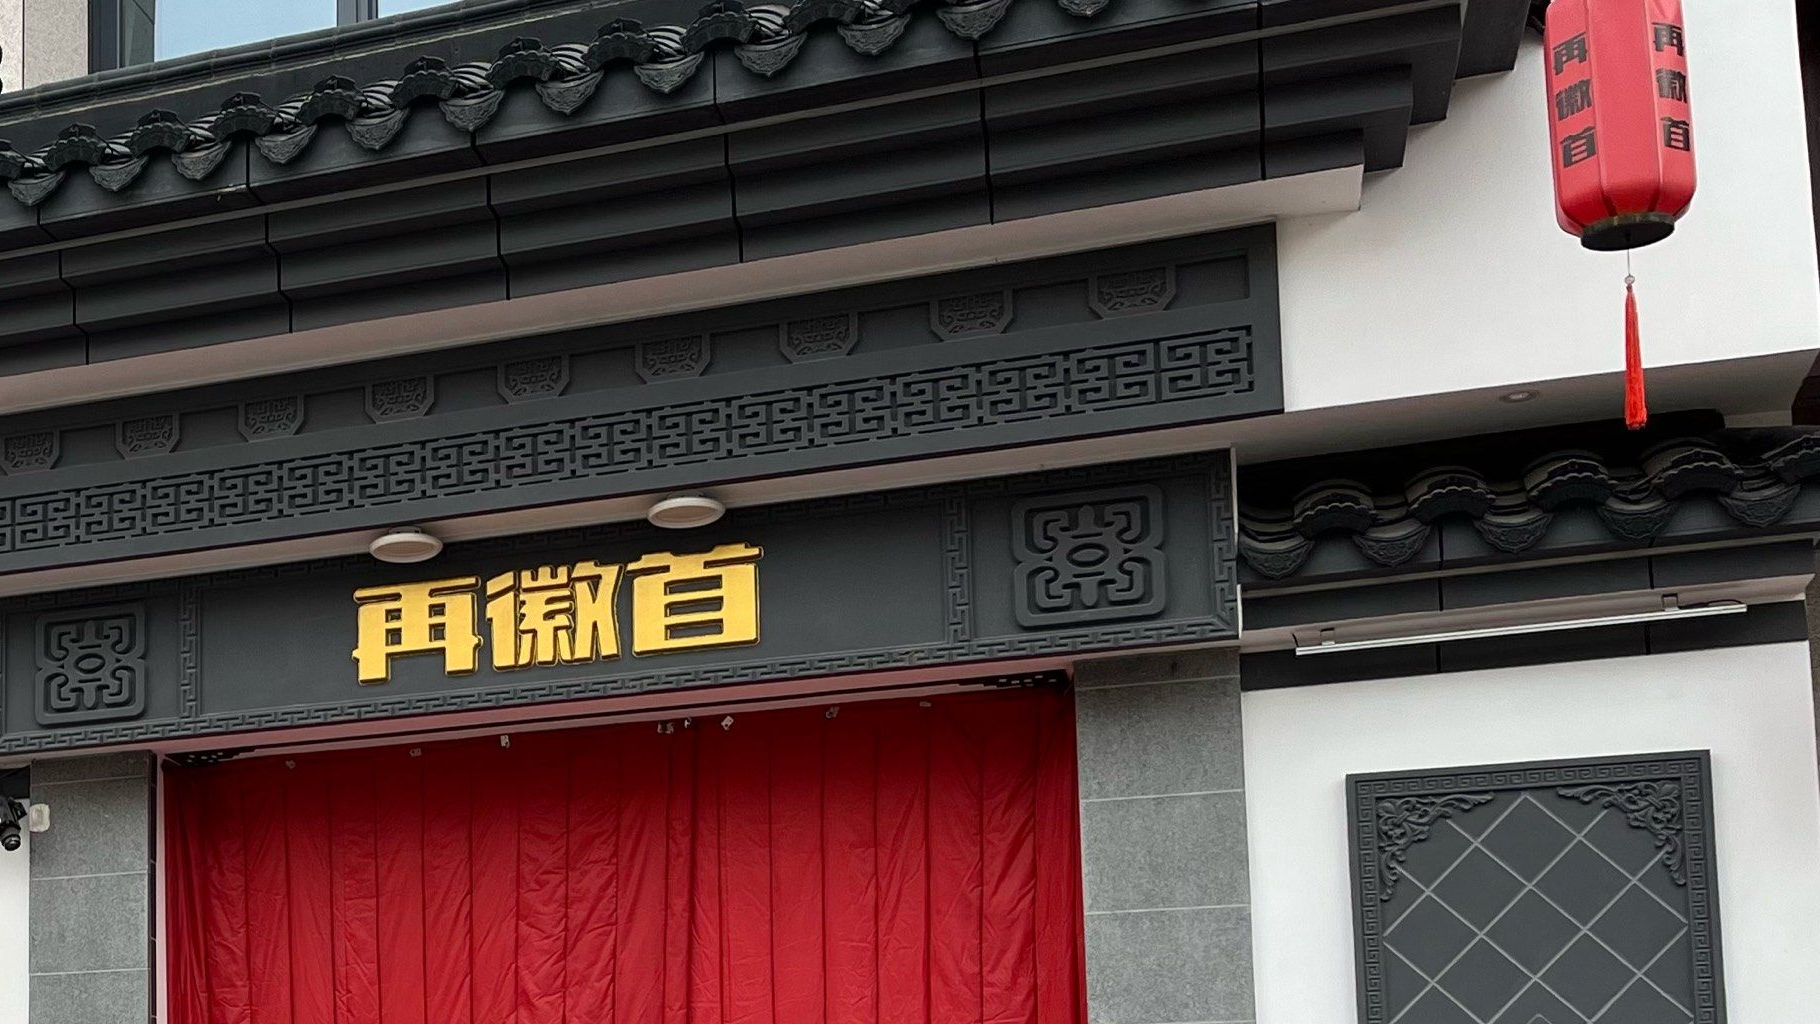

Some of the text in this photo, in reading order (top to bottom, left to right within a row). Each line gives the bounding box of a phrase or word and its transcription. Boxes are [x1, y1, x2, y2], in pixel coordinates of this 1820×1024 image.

[1553, 32, 1596, 169] 再徽首
[352, 542, 765, 686] 再徽首
